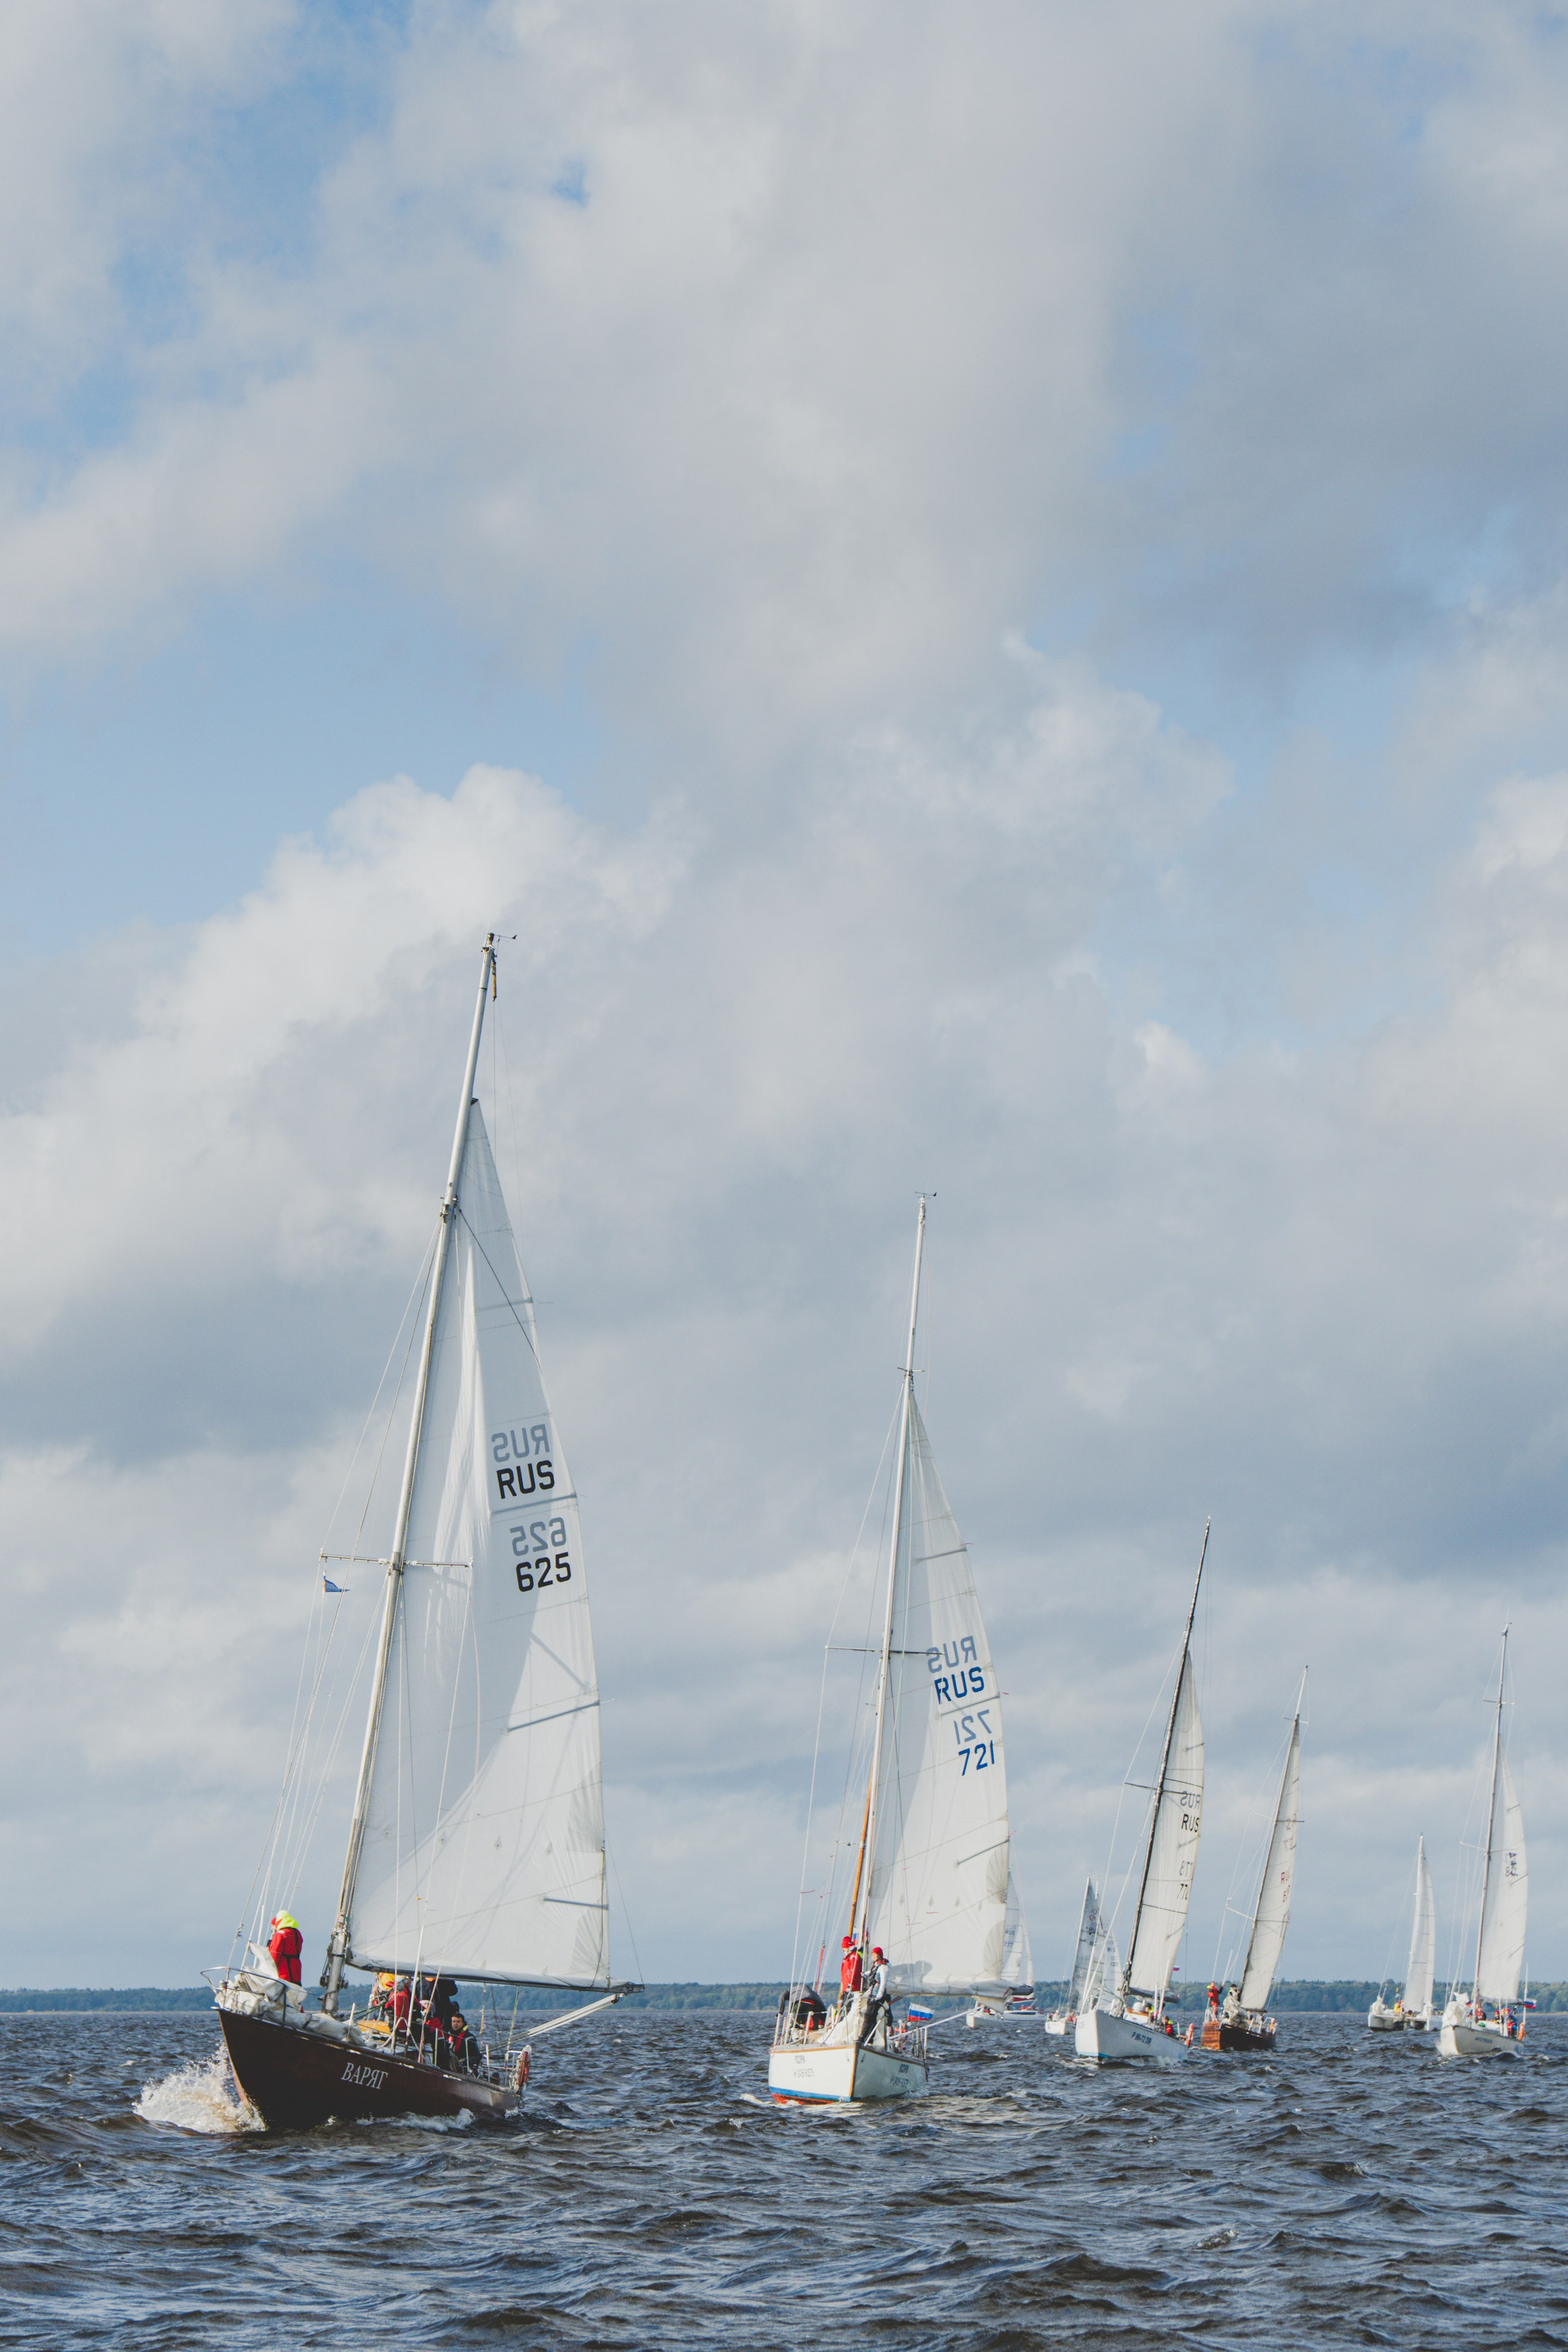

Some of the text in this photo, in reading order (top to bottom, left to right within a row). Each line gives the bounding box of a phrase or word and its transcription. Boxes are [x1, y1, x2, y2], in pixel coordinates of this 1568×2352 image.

[496, 1460, 555, 1499] RUS
[516, 1551, 571, 1593] 625
[934, 1667, 984, 1705] RUS
[958, 1740, 995, 1776] 721
[1182, 1813, 1199, 1833] RUS
[341, 2062, 388, 2089] ВАРЯГ
